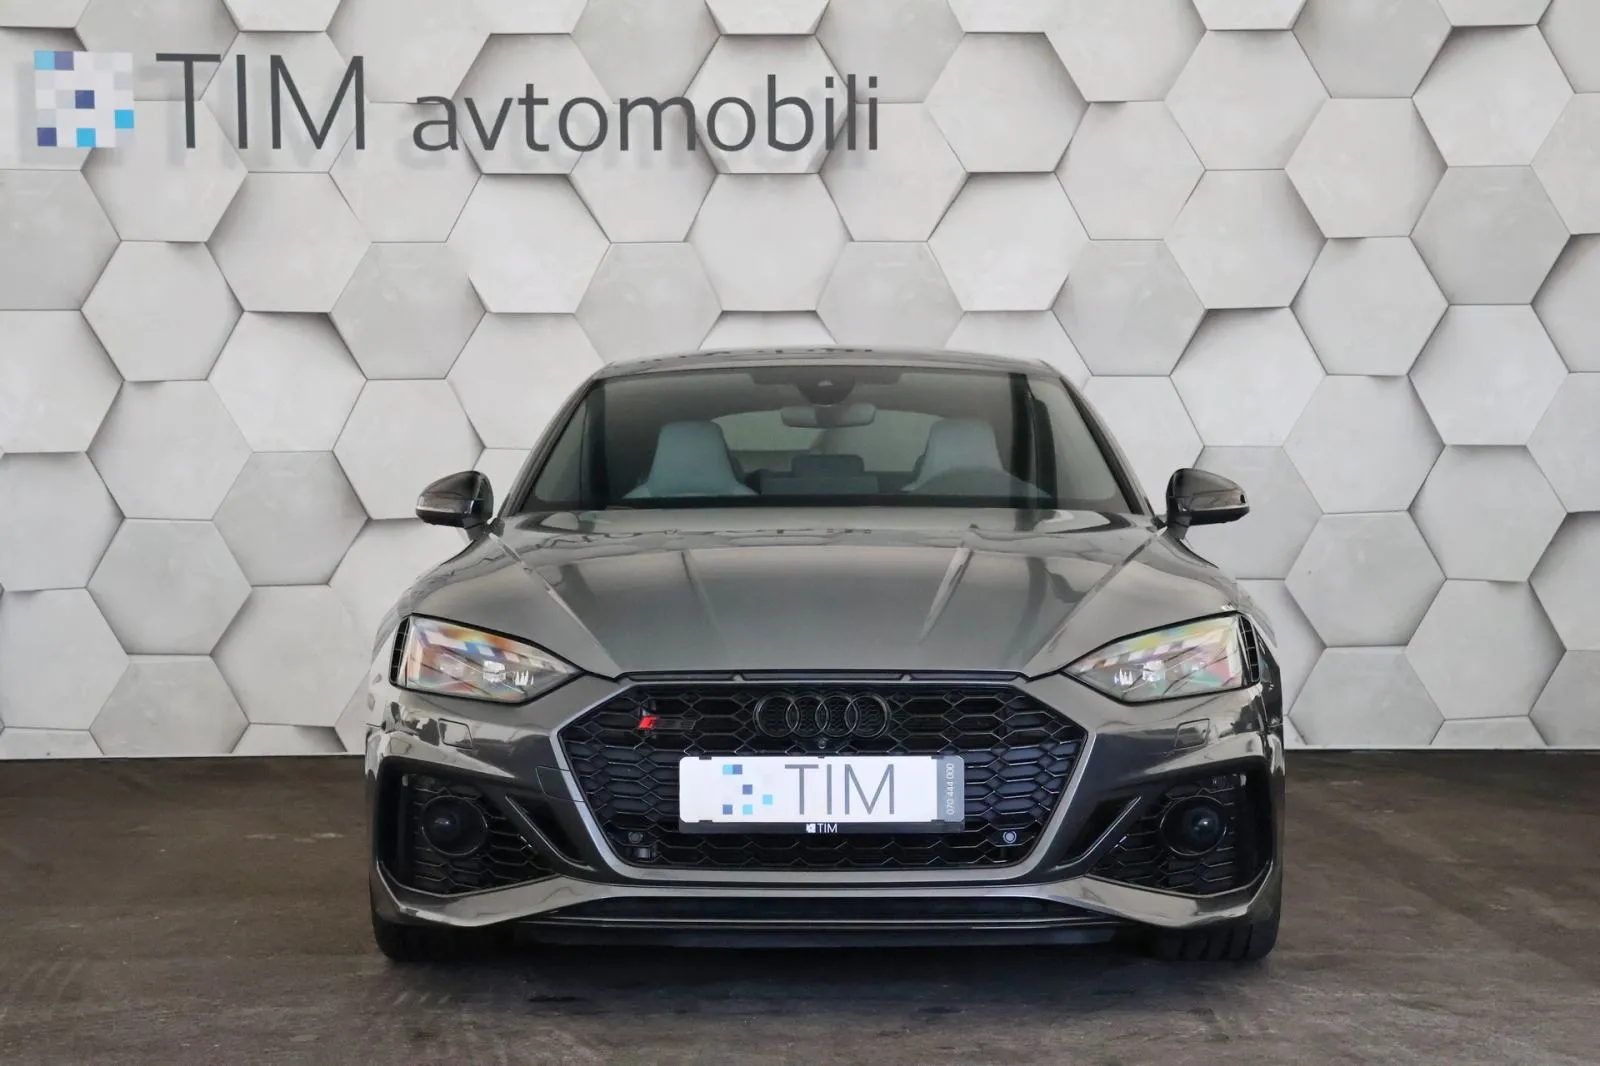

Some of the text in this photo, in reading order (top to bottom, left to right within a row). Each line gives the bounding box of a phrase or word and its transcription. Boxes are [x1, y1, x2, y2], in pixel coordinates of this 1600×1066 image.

[156, 52, 879, 152] TIM avtomobili
[785, 764, 895, 815] TIM
[945, 763, 955, 815] 070 444 000
[817, 823, 838, 833] TIM
